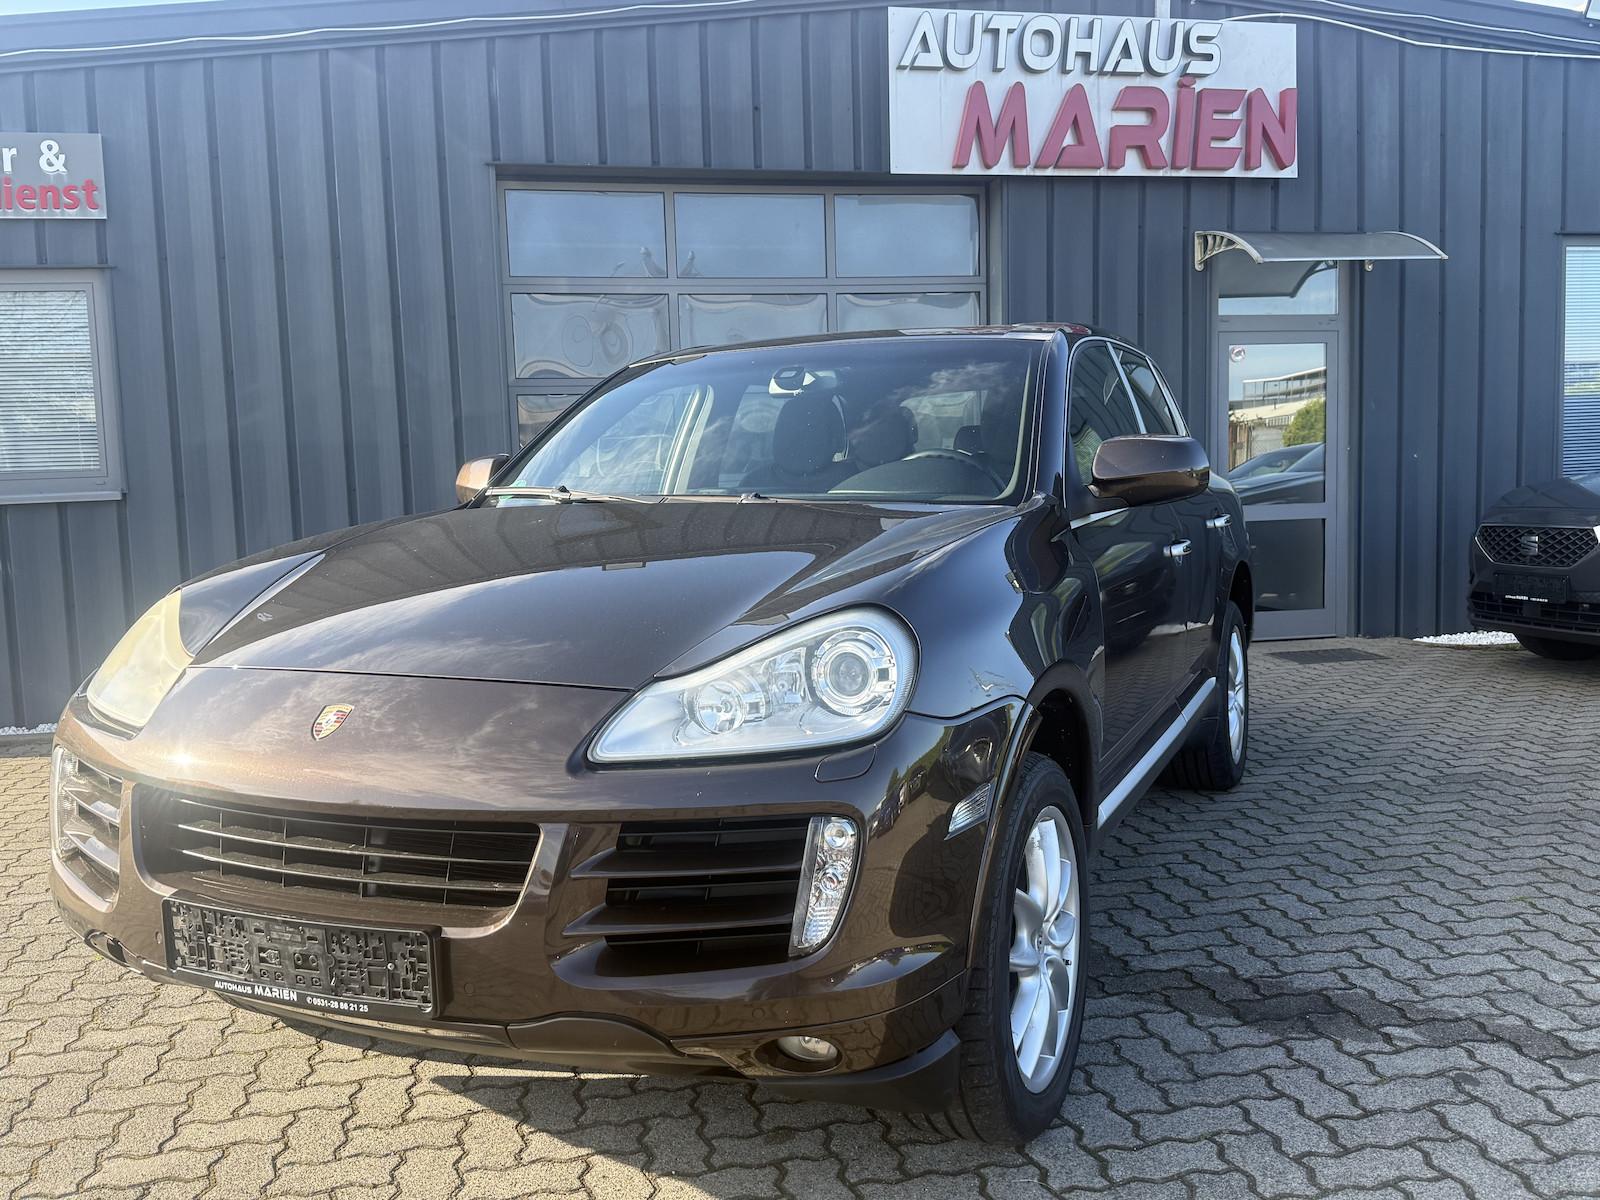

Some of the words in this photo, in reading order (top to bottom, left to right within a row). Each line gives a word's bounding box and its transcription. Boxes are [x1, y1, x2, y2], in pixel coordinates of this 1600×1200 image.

[897, 10, 1223, 77] AUTOHAUS
[952, 76, 1298, 171] MARIEN
[39, 139, 68, 175] &
[0, 176, 100, 212] ienst
[214, 980, 252, 994] AUTOHAUS
[254, 984, 298, 1001] MARIEN
[349, 1003, 358, 1011] 21
